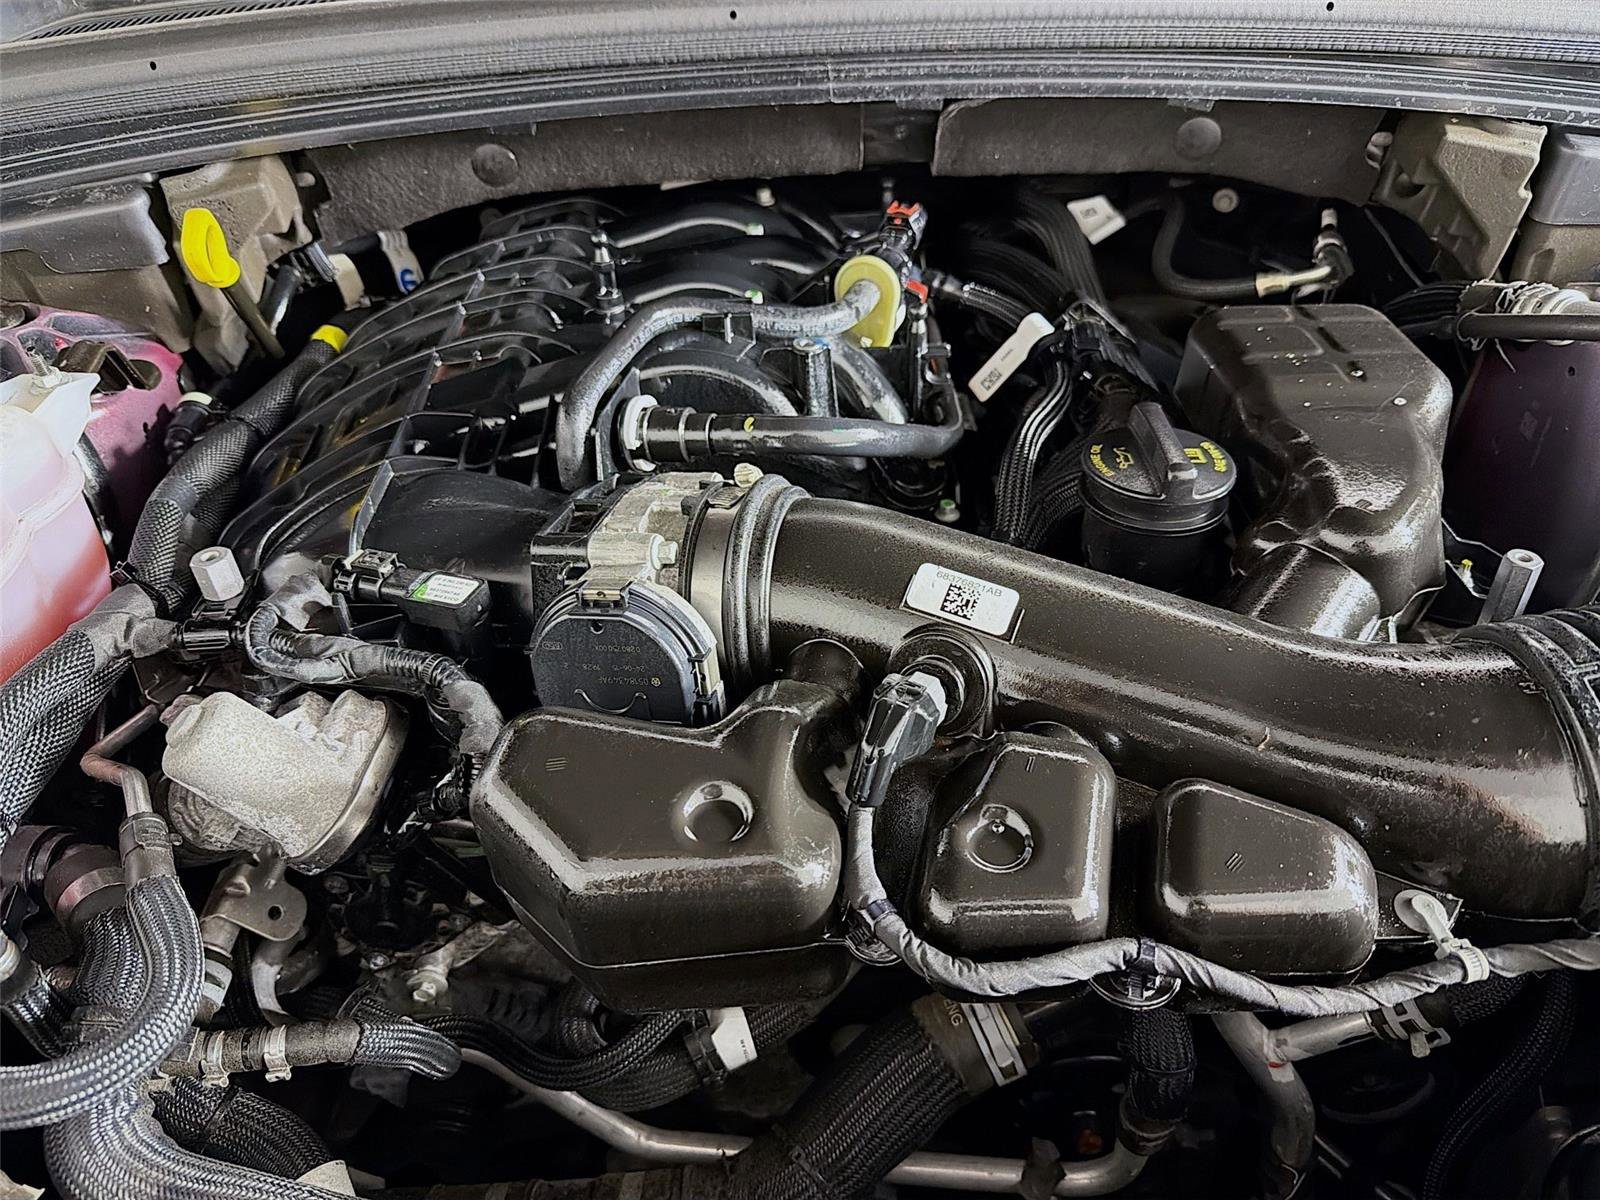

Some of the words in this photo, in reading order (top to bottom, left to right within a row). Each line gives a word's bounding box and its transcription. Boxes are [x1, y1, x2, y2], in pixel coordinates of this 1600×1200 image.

[1090, 454, 1116, 477] ENGINE
[936, 569, 1003, 597] 68376821AB
[944, 999, 963, 1026] ENG
